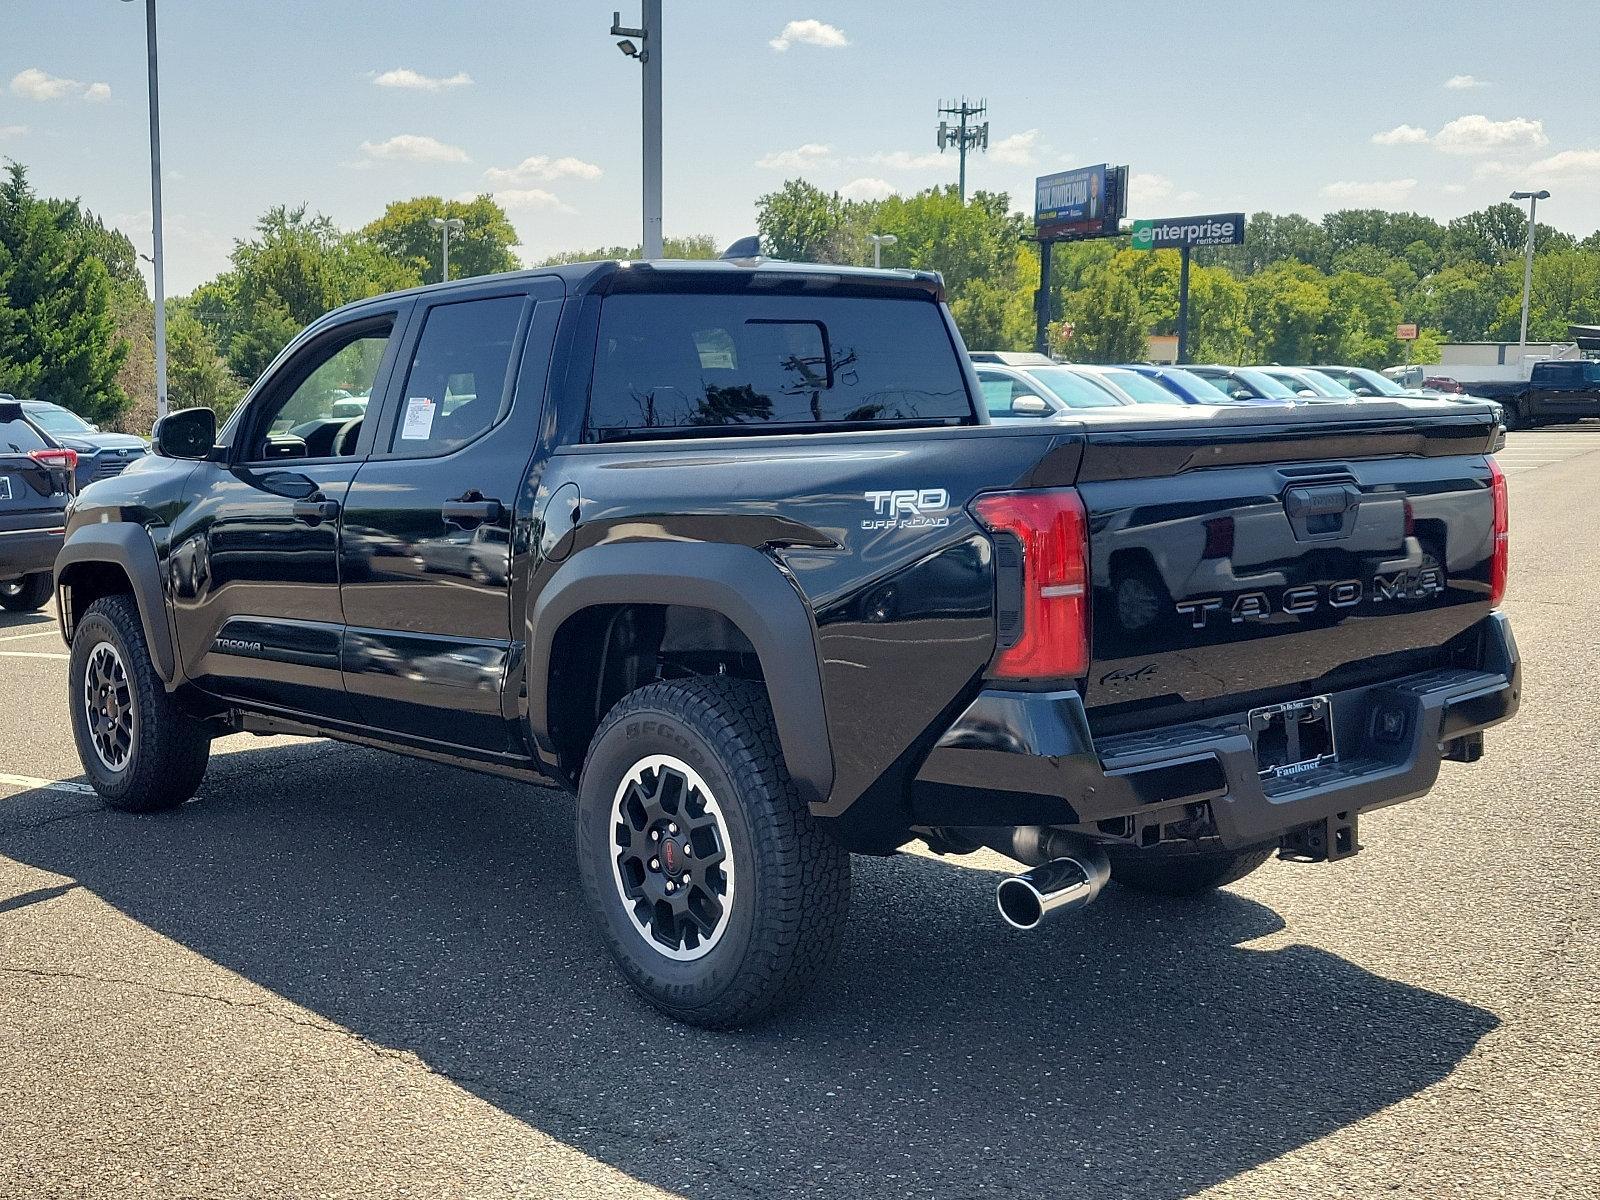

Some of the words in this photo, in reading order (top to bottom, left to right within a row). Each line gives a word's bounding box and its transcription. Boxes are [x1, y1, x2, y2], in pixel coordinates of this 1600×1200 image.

[1134, 219, 1235, 243] enterprise
[1196, 236, 1234, 245] rent-a-car
[864, 488, 950, 519] TRD
[861, 519, 897, 530] OFF
[898, 517, 950, 529] ROAD
[1176, 566, 1446, 629] TACOMA
[215, 638, 262, 651] TACOMA
[1275, 762, 1320, 777] Faulkner
